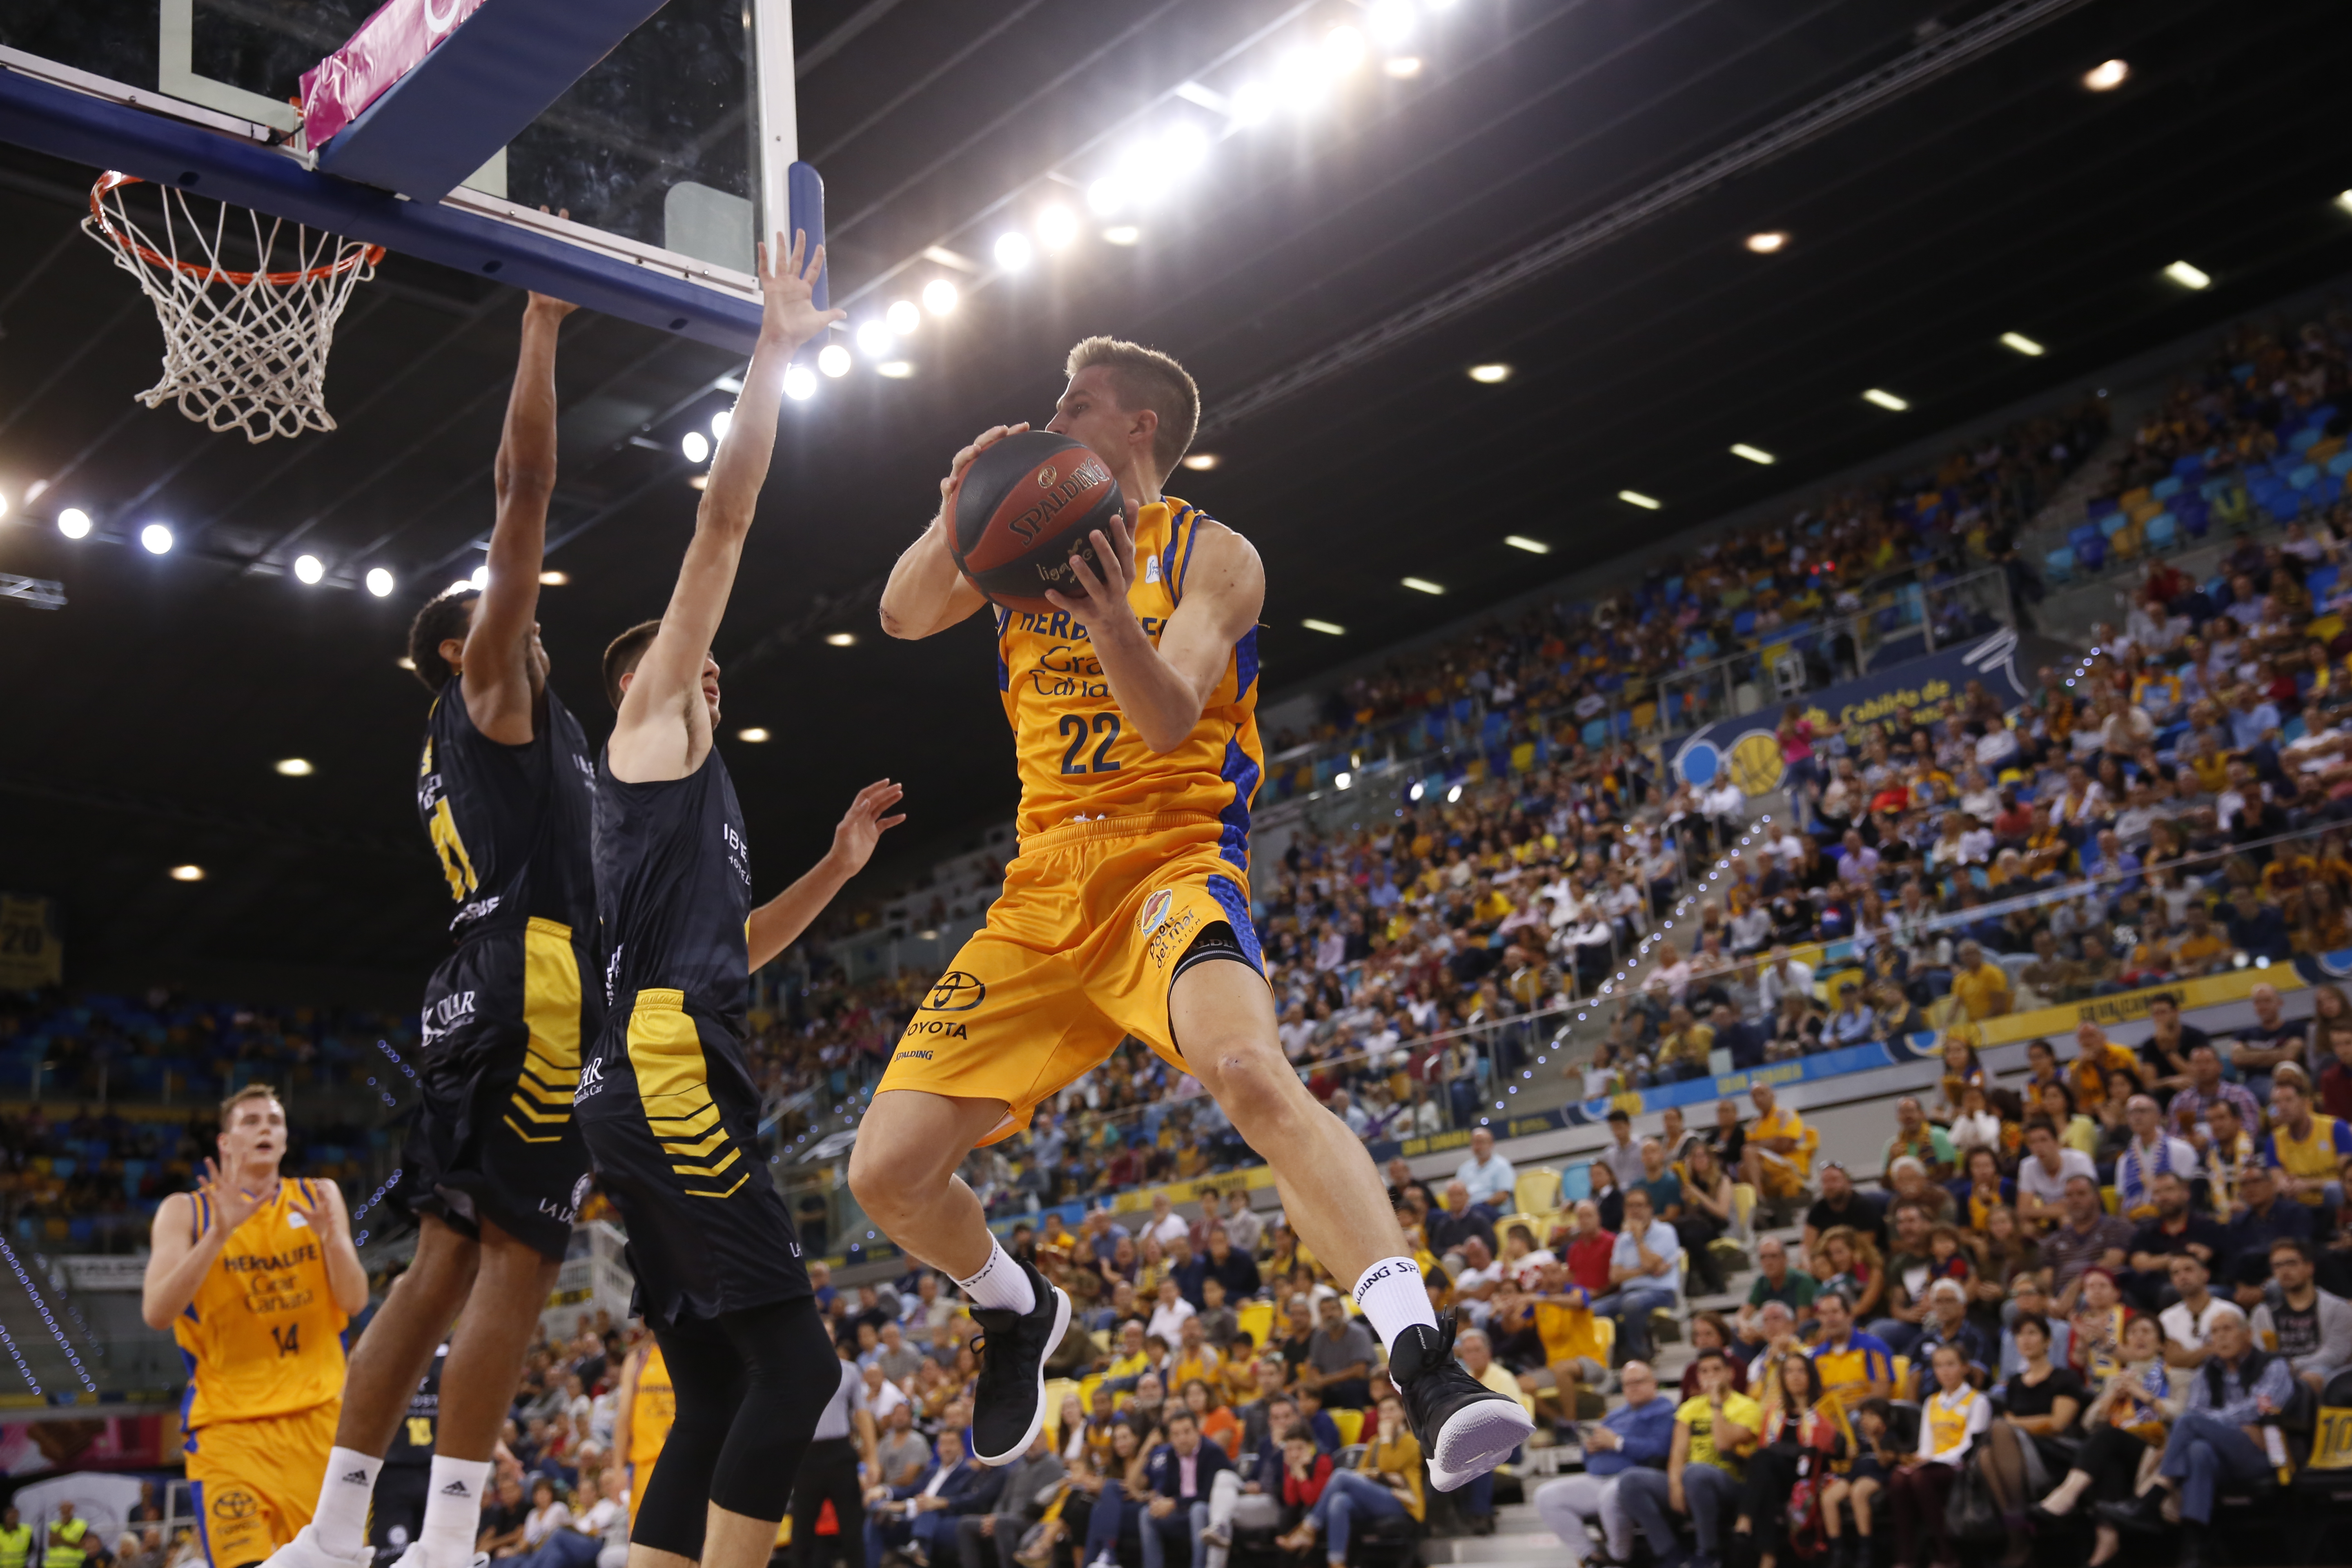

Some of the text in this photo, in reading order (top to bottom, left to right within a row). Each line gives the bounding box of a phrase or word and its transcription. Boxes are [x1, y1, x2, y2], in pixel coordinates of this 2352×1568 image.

[1008, 456, 1110, 548] SPALDING
[1036, 562, 1071, 581] liga
[1040, 646, 1106, 675] Gra
[1059, 712, 1121, 775] 22
[902, 1021, 967, 1040] TOYOTA
[894, 1050, 934, 1062] SPALDING
[272, 1321, 299, 1358] 14
